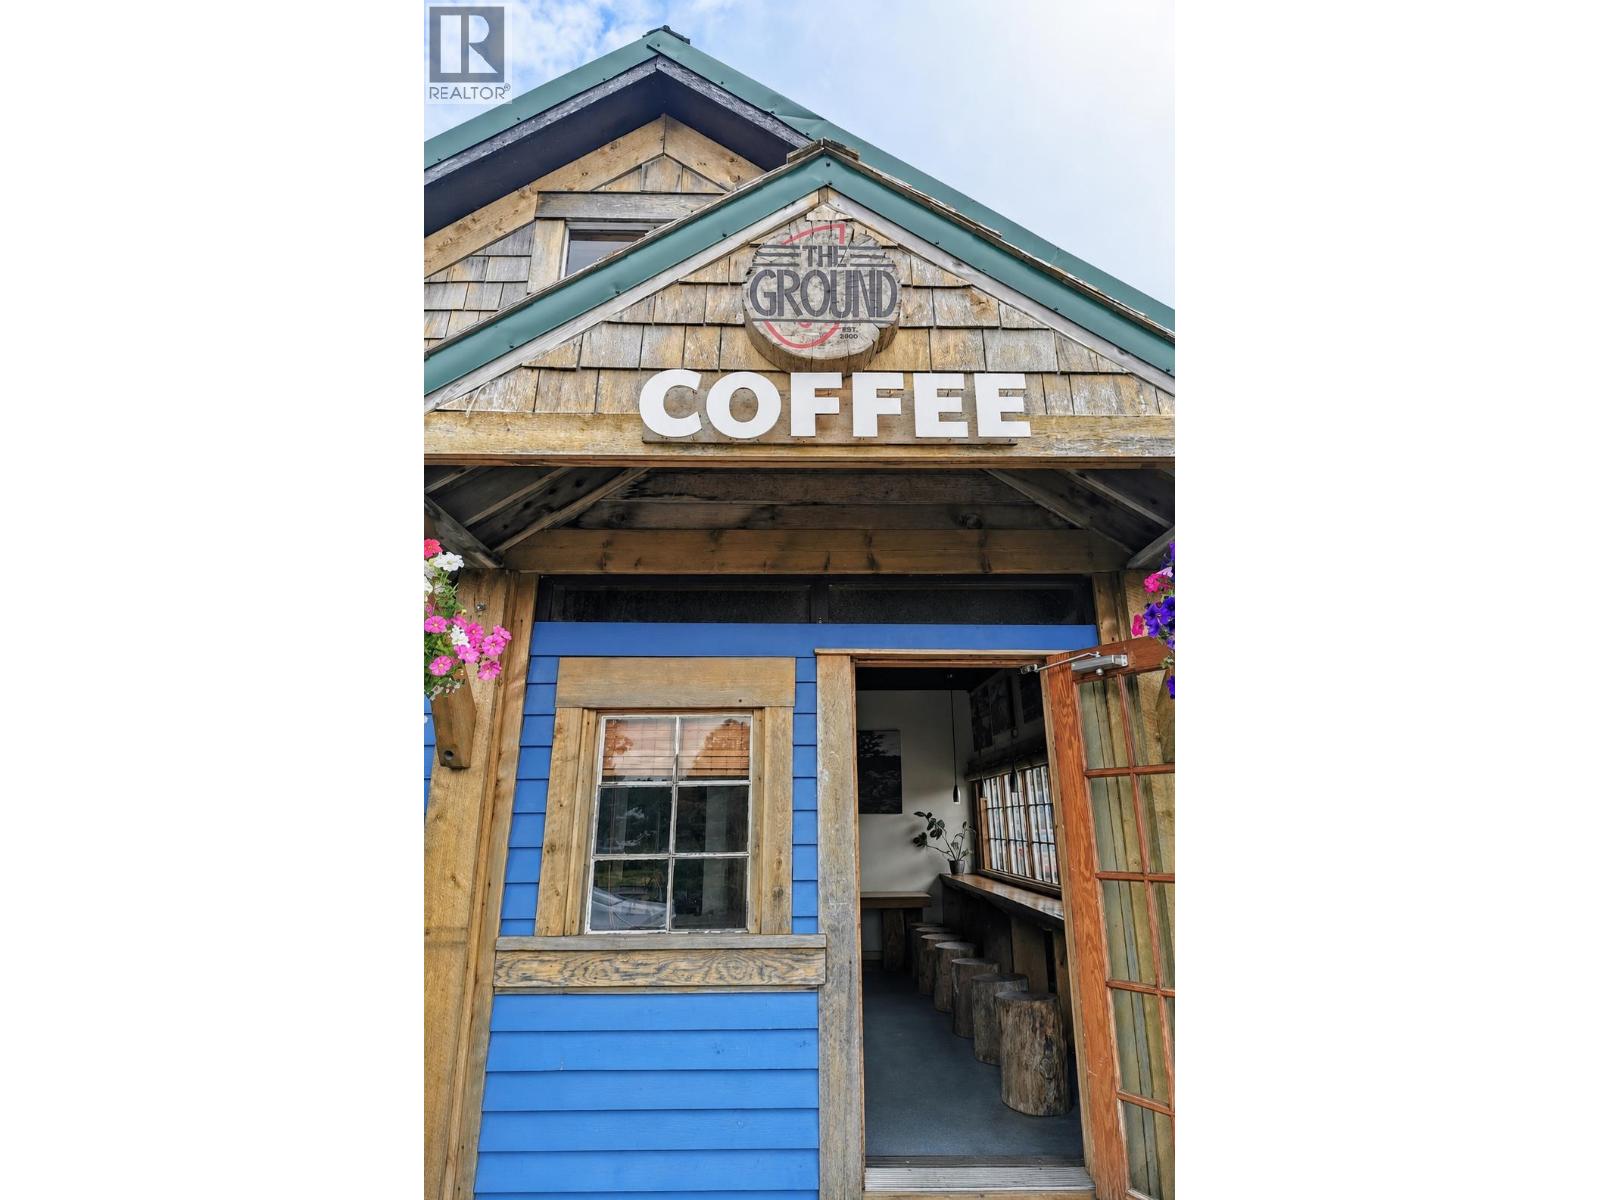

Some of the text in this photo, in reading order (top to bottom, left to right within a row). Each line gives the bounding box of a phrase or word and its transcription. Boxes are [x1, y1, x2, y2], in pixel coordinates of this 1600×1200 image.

[802, 245, 848, 268] THE
[750, 269, 898, 319] GROUND
[639, 368, 1032, 439] COFFEE
